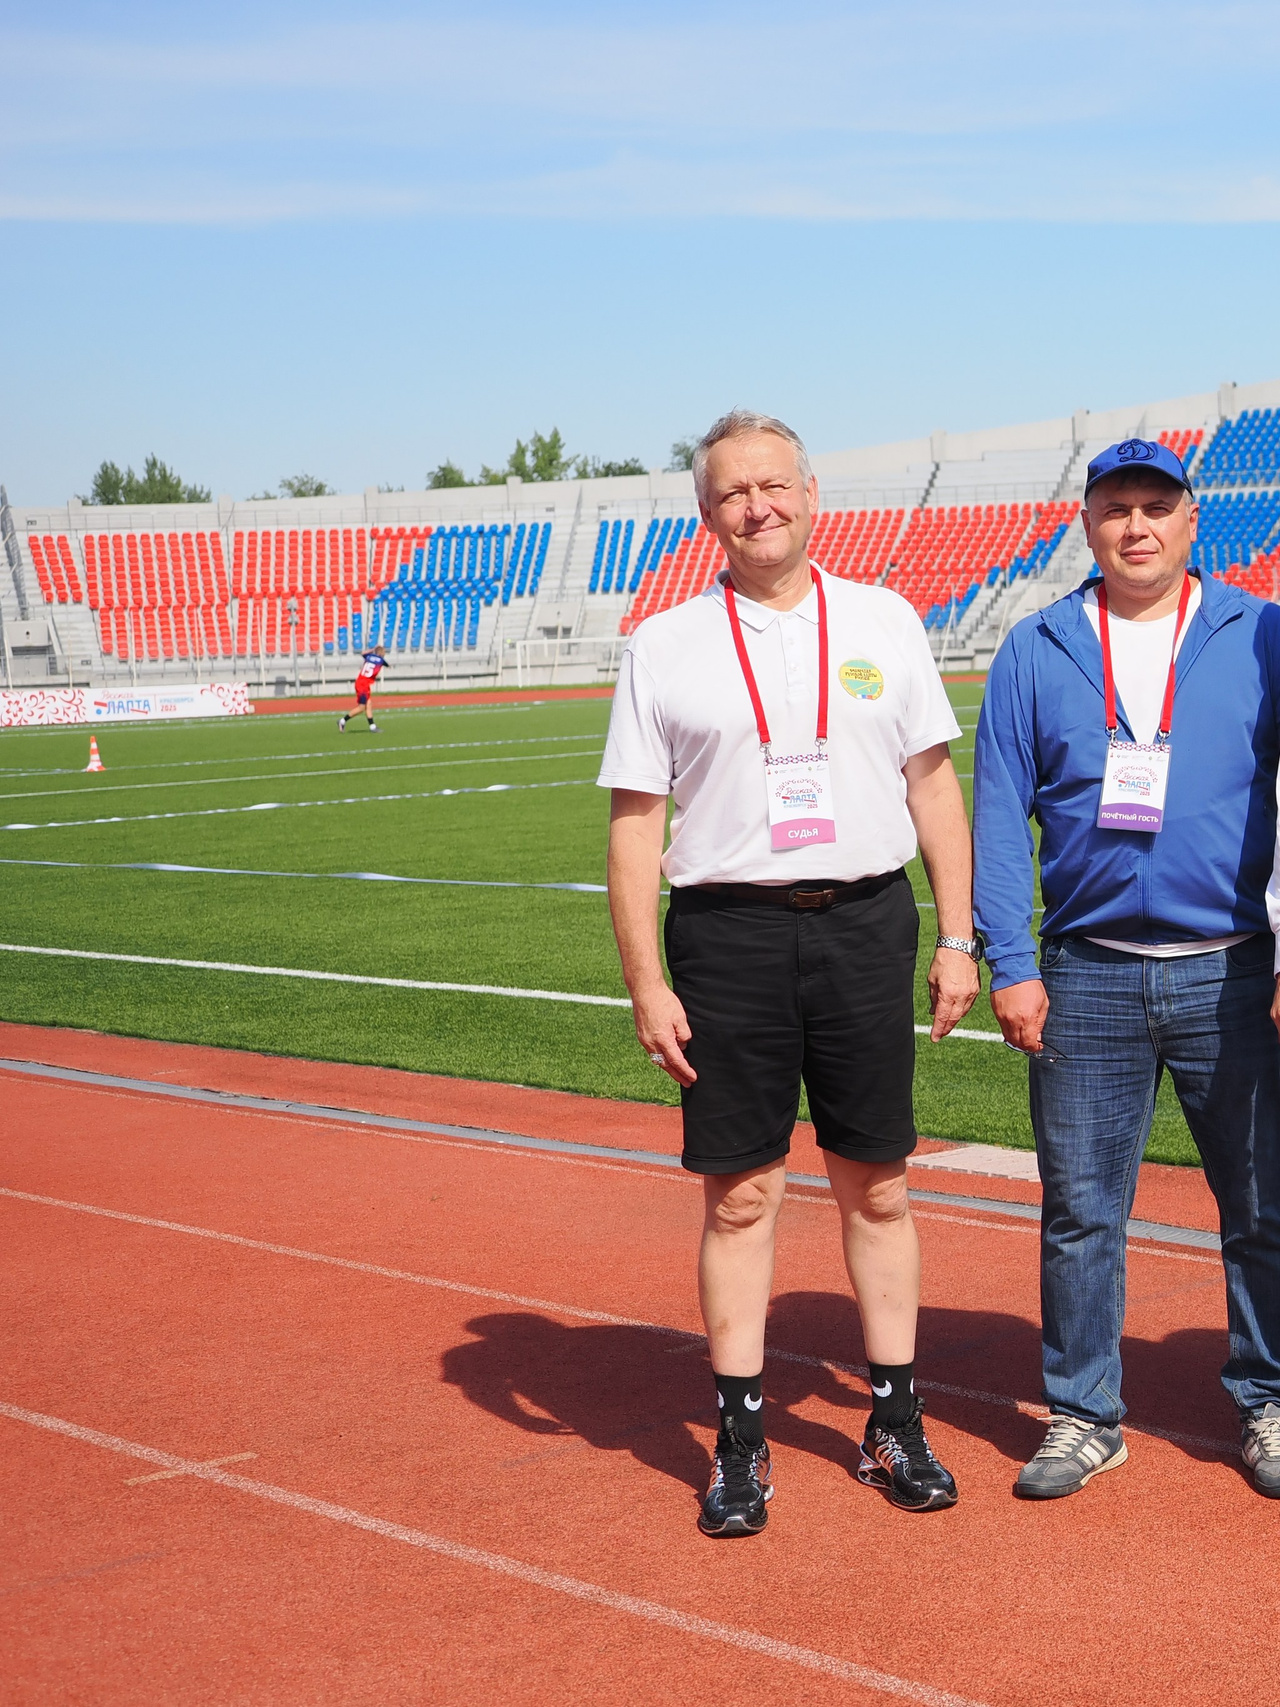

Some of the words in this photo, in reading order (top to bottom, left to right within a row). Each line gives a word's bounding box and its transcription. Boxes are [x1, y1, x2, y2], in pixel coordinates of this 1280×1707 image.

[361, 662, 377, 678] 15
[106, 699, 151, 714] ЛАПТА
[1124, 780, 1151, 791] ЛАПТА
[789, 793, 818, 804] ЛАПТА
[1101, 812, 1137, 821] ПОЧЁТНЫЙ
[1138, 814, 1159, 823] ГОСТЬ
[788, 828, 818, 839] СУДЬЯ
